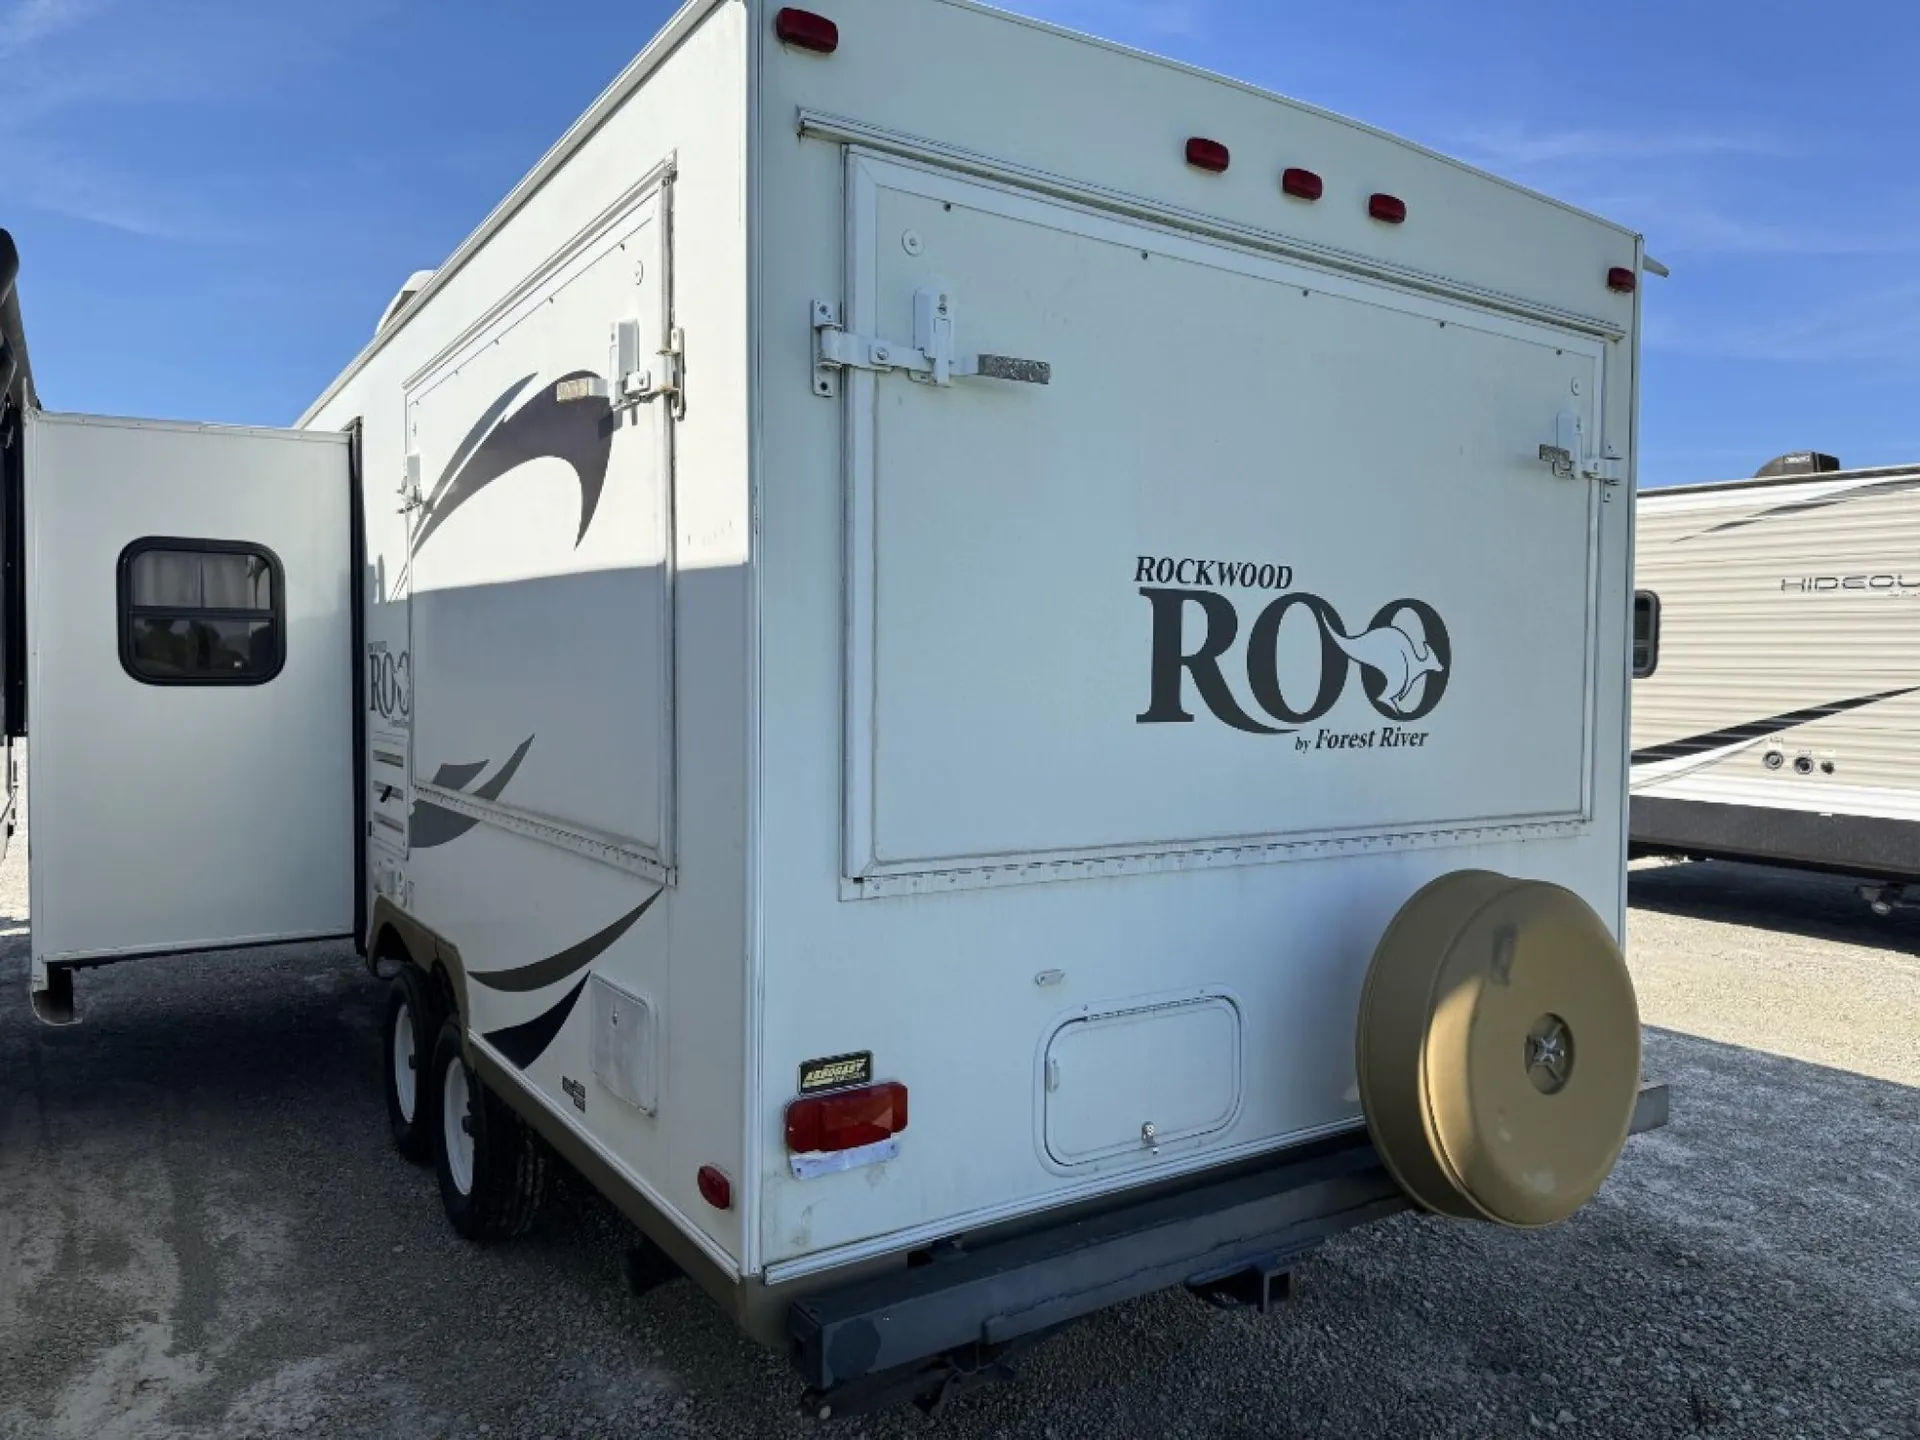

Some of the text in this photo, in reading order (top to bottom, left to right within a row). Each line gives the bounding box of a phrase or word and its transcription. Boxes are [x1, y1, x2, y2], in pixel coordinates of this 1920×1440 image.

[1134, 556, 1293, 589] ROCKWOOD
[1136, 587, 1451, 735] ROO
[1295, 726, 1429, 753] by Forest River
